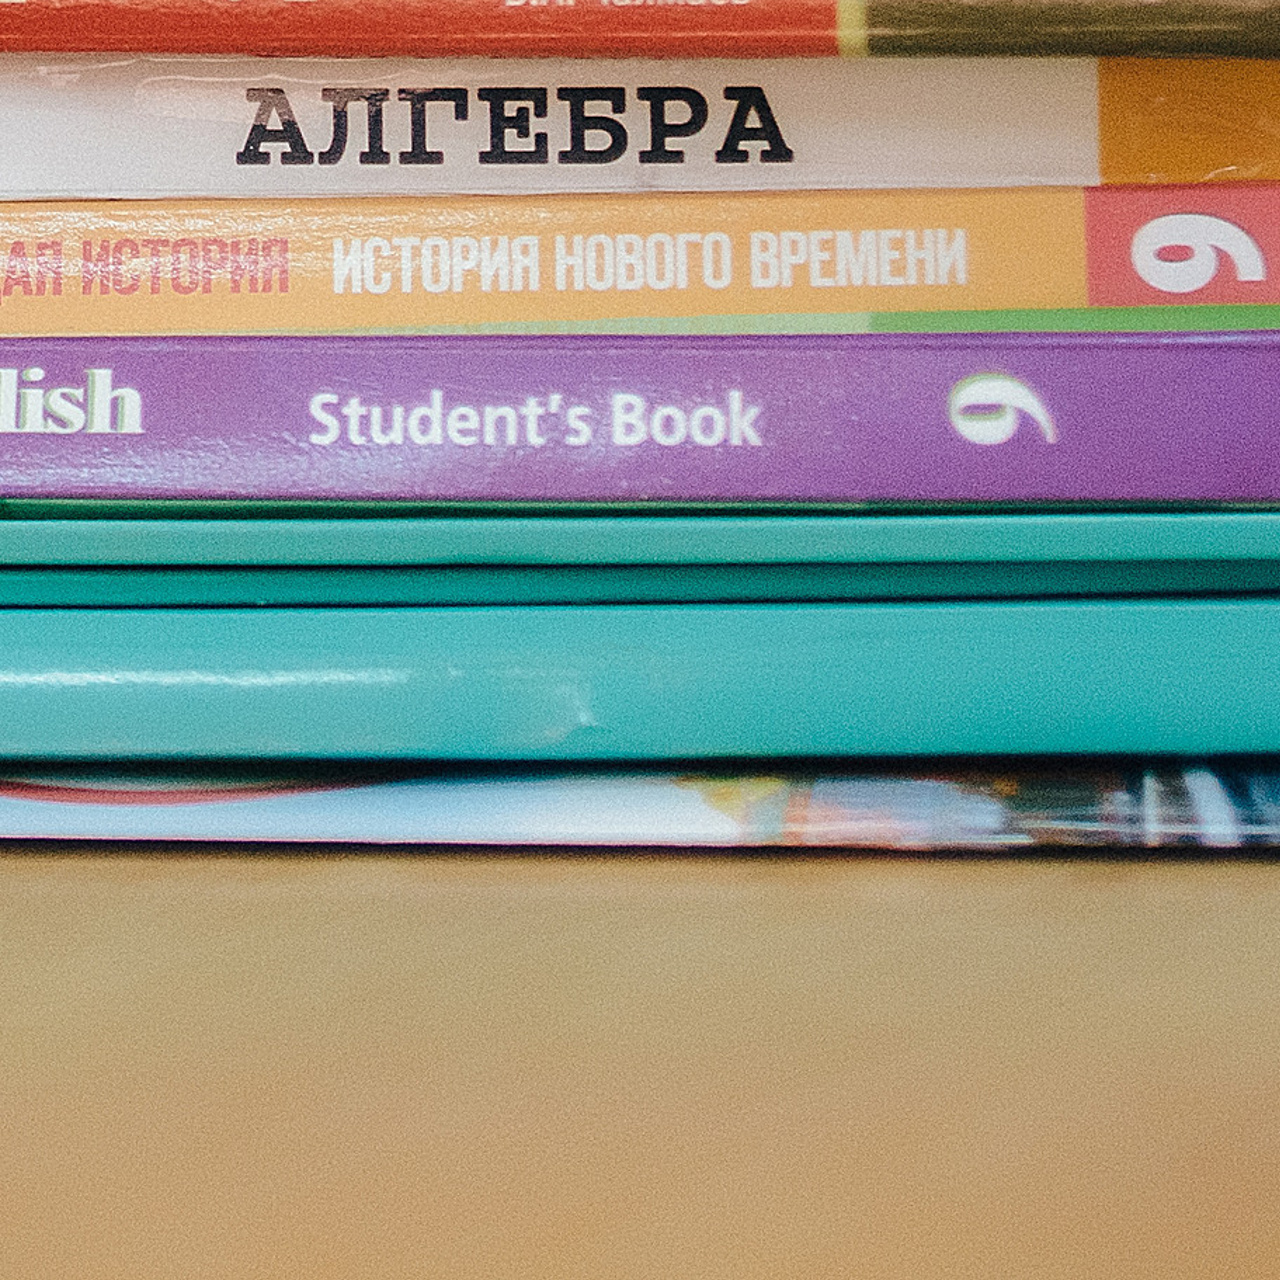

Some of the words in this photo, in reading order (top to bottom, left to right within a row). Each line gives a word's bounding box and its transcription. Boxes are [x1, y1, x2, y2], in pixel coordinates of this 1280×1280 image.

[236, 85, 795, 165] АЛГЕБРА
[81, 237, 289, 297] ИСТОРИЯ
[331, 235, 540, 296] ИСТОРИЯ
[554, 231, 733, 293] НОВОГО
[750, 227, 968, 289] ВРЕМЕНИ
[1130, 212, 1267, 295] 9
[612, 391, 763, 448] Book
[948, 370, 1058, 444] 9
